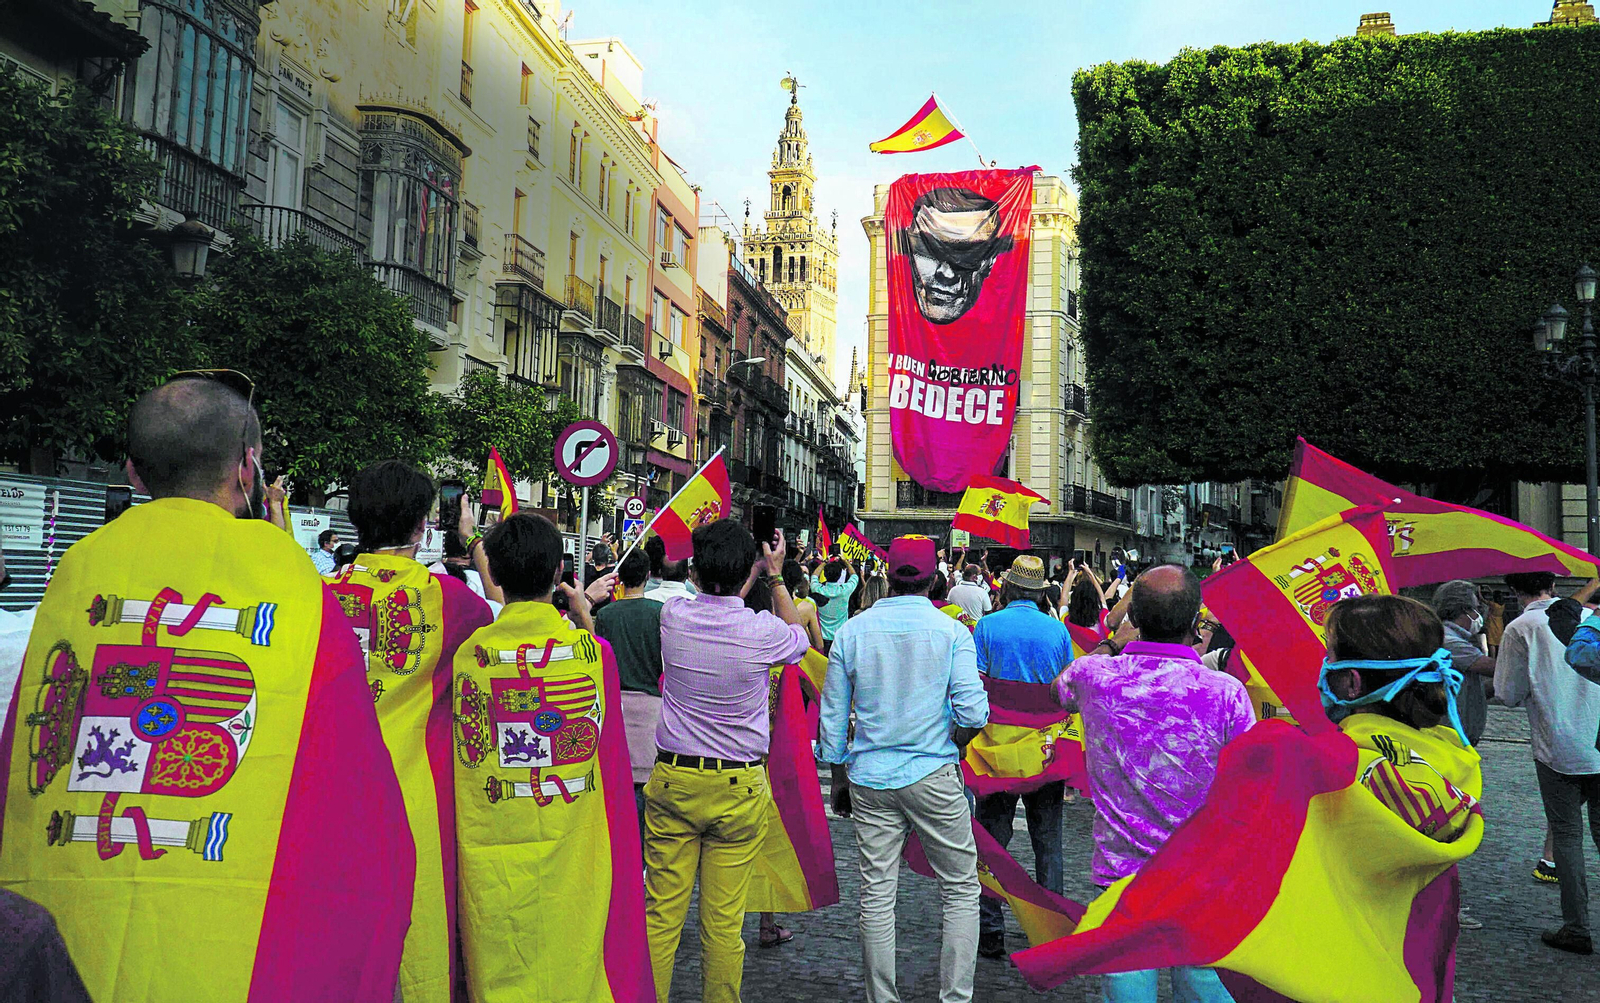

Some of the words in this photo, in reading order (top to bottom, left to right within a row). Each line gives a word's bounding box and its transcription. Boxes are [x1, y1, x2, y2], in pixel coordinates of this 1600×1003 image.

[895, 355, 925, 378] BUEN
[888, 373, 1004, 425] BEDECE
[629, 502, 643, 511] 20
